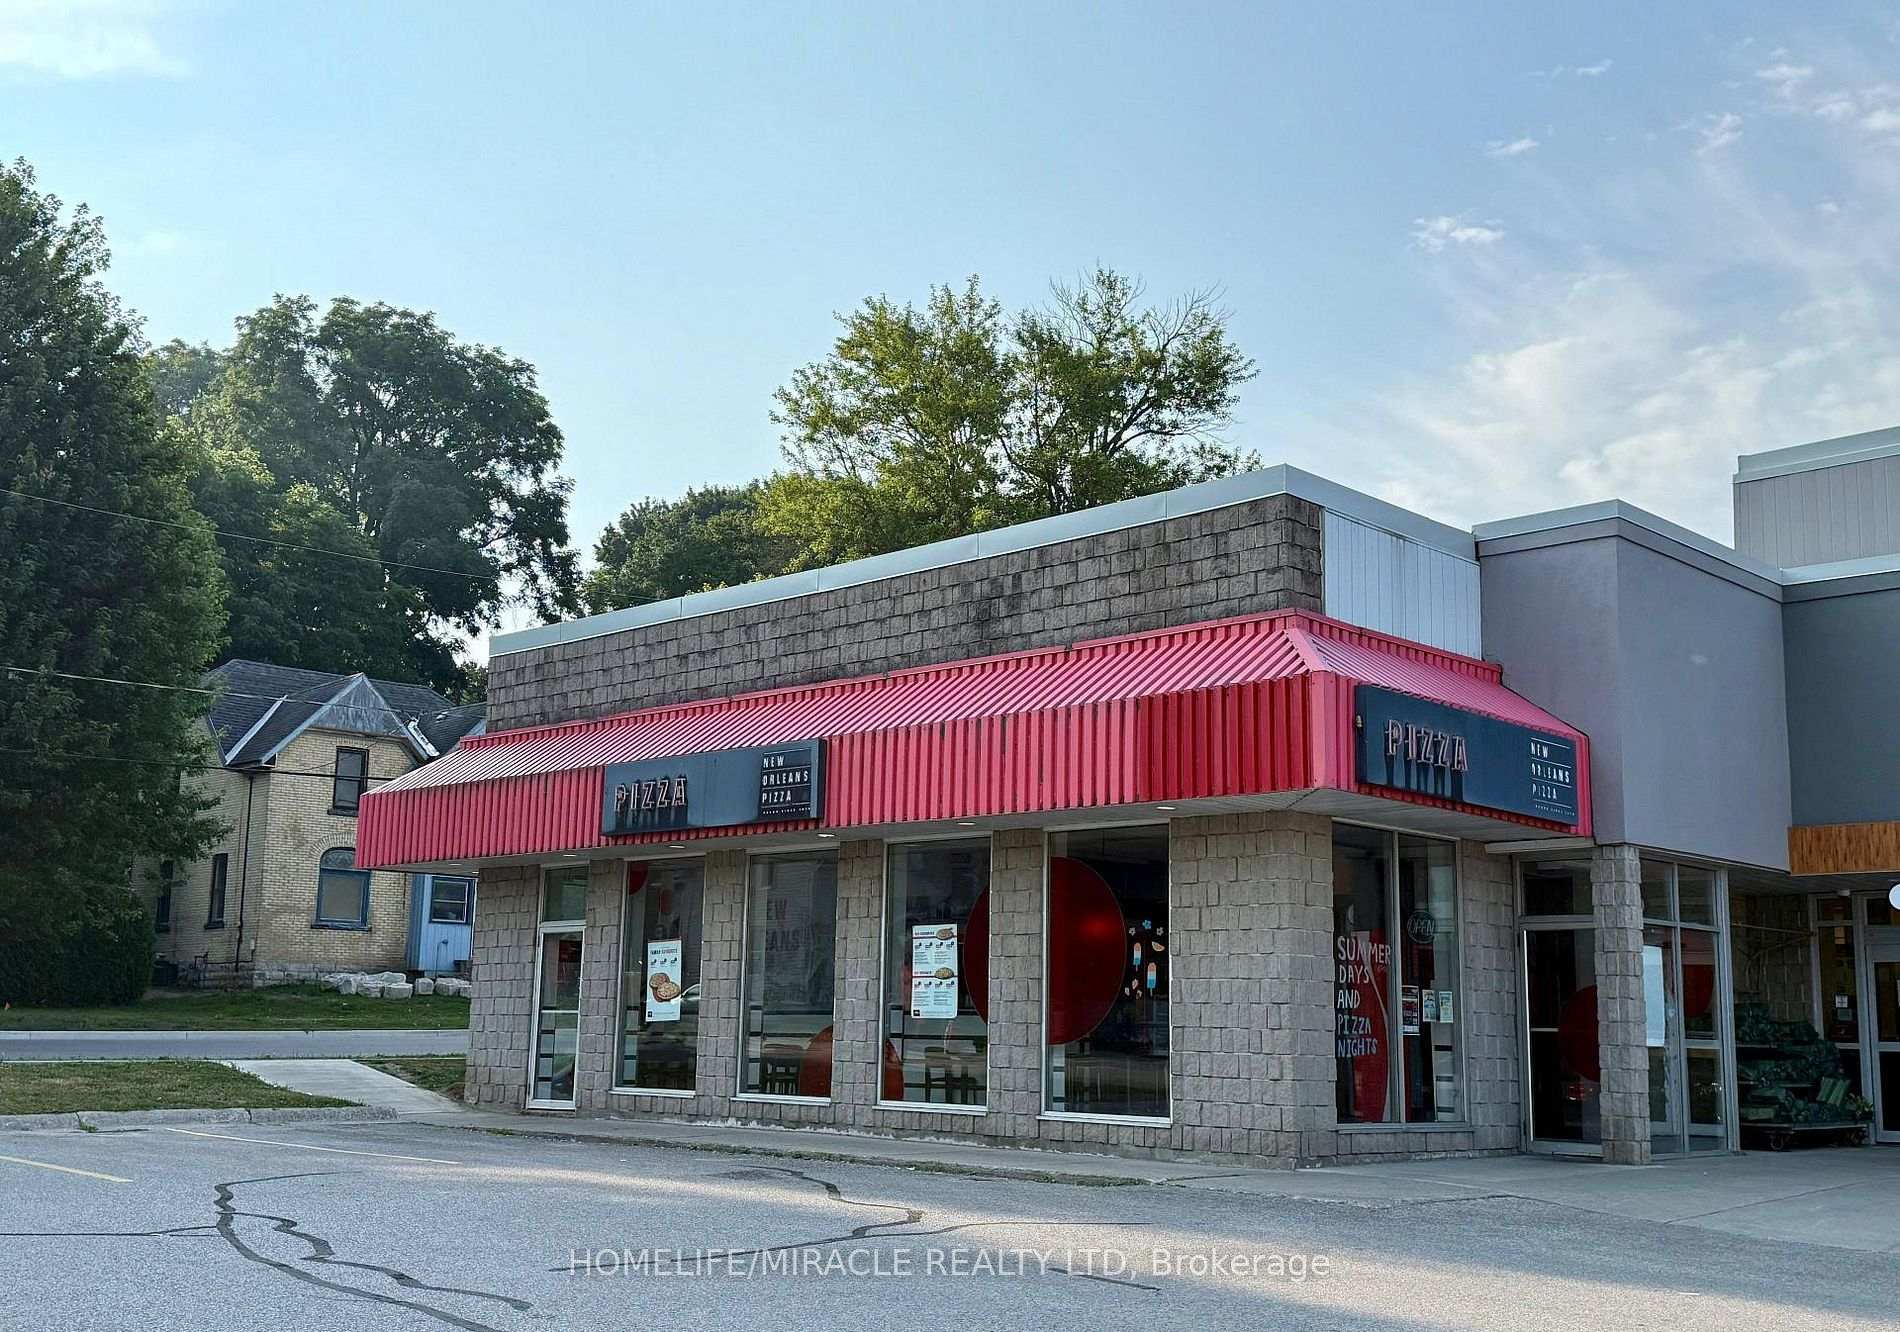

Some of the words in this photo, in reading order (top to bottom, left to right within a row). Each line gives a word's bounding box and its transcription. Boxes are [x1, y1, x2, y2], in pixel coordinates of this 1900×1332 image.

[1385, 719, 1469, 772] PIZZA
[1530, 742, 1549, 758] NEW
[763, 755, 785, 768] NEW
[762, 770, 809, 786] ORLEANS
[1531, 762, 1570, 783] ORLEANS
[614, 777, 688, 812] PIZZA
[762, 789, 792, 804] PIZZA
[1532, 783, 1557, 800] PIZZA
[1337, 936, 1391, 965] SUMMER
[1339, 965, 1370, 984] DAYS
[1337, 989, 1361, 1009] AND
[1337, 1013, 1372, 1035] PIZZA
[1337, 1037, 1378, 1058] NIGHTS
